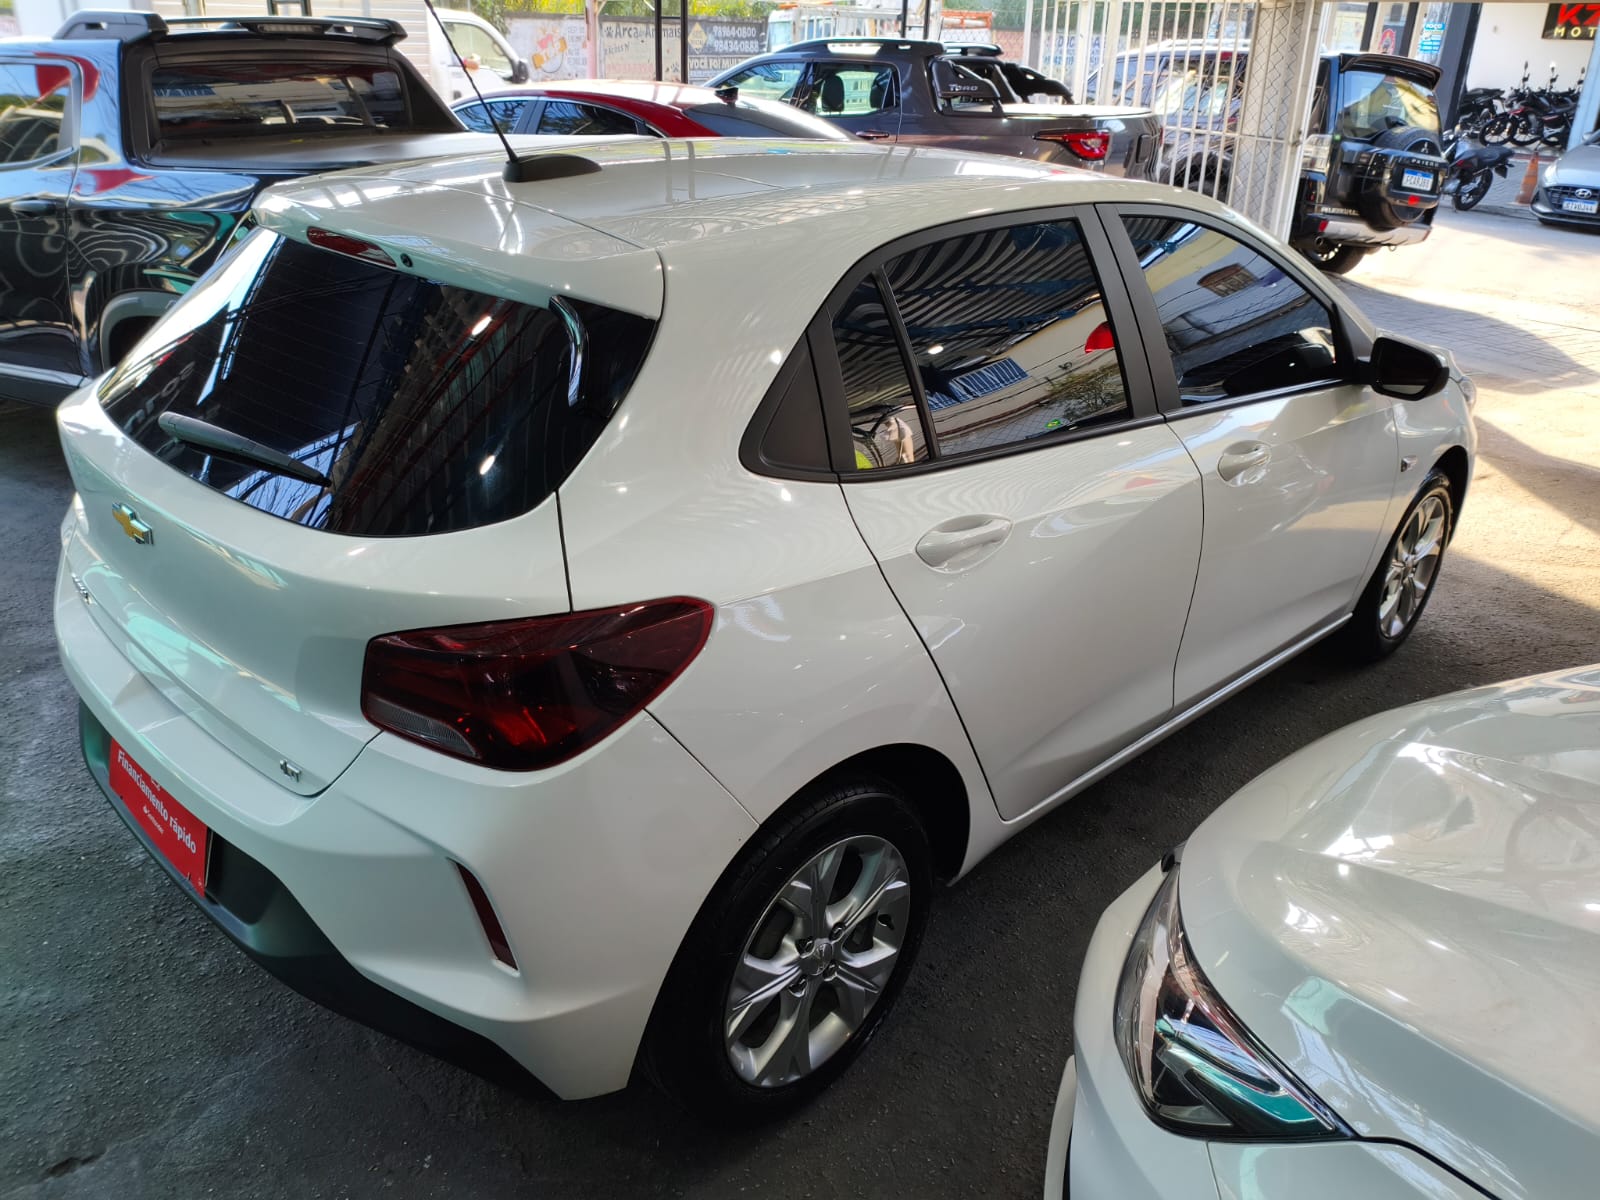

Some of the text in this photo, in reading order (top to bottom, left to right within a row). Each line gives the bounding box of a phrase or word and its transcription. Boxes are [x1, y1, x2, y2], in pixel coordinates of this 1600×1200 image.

[615, 24, 639, 39] Arca
[645, 24, 682, 39] Anmais
[117, 749, 197, 855] Financiamento rápido
